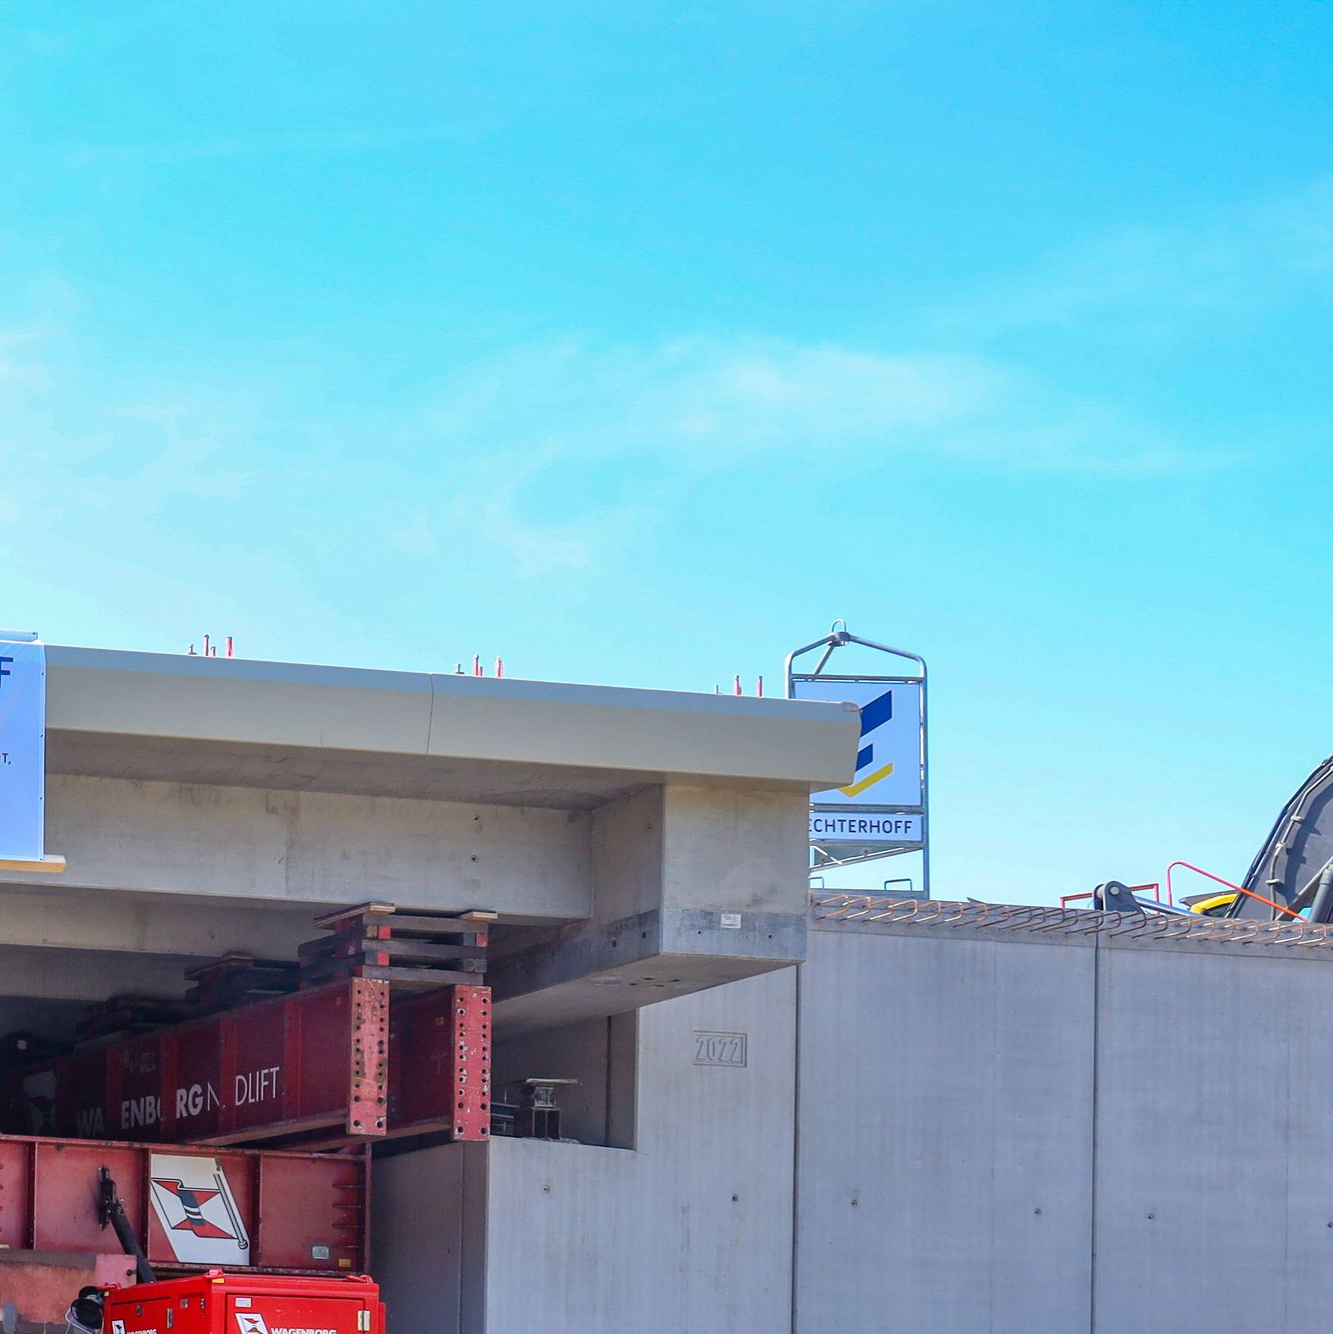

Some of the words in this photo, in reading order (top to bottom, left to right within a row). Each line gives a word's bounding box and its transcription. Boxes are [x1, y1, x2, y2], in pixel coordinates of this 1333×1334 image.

[694, 1036, 739, 1063] 2022
[76, 1083, 204, 1139] WAENBRG
[206, 1066, 281, 1113] NDLIFT
